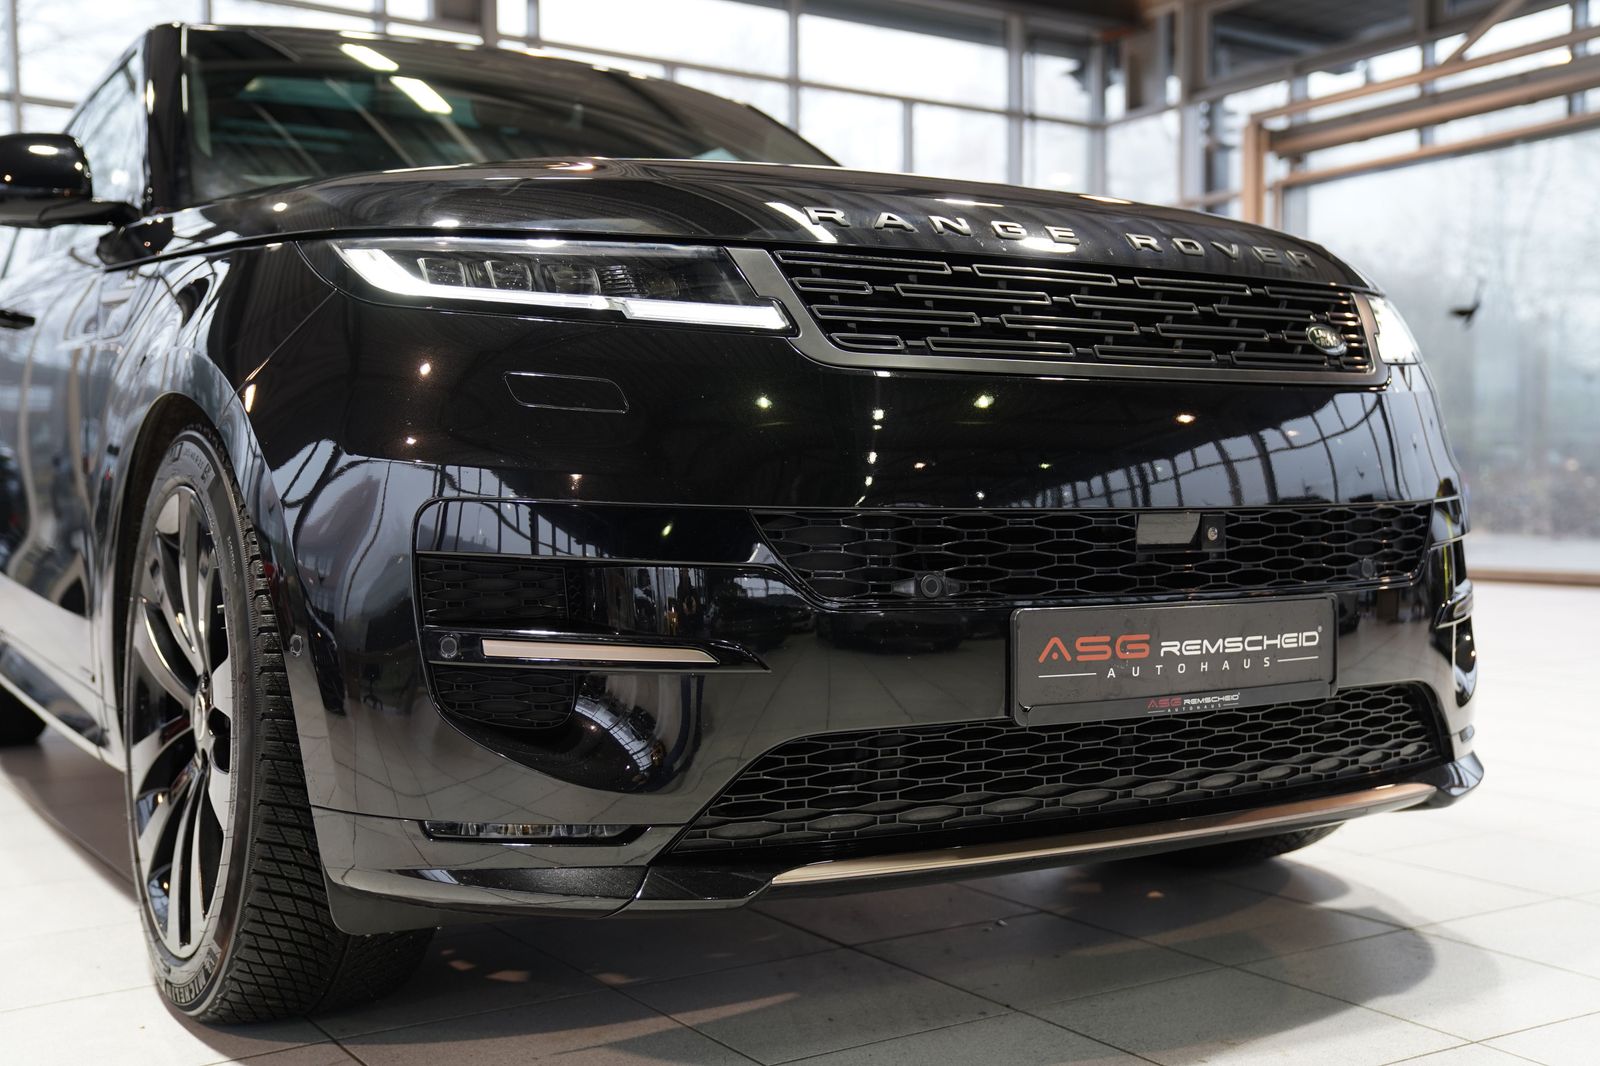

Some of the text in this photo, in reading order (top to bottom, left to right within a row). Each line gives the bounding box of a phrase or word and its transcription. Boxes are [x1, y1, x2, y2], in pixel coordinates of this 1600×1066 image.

[801, 206, 1317, 268] RANGE ROVER
[1038, 633, 1150, 664] ASG
[1106, 656, 1271, 679] AUTOHAUS
[1147, 696, 1182, 709] ASG
[1167, 703, 1222, 713] AUTOHAUS
